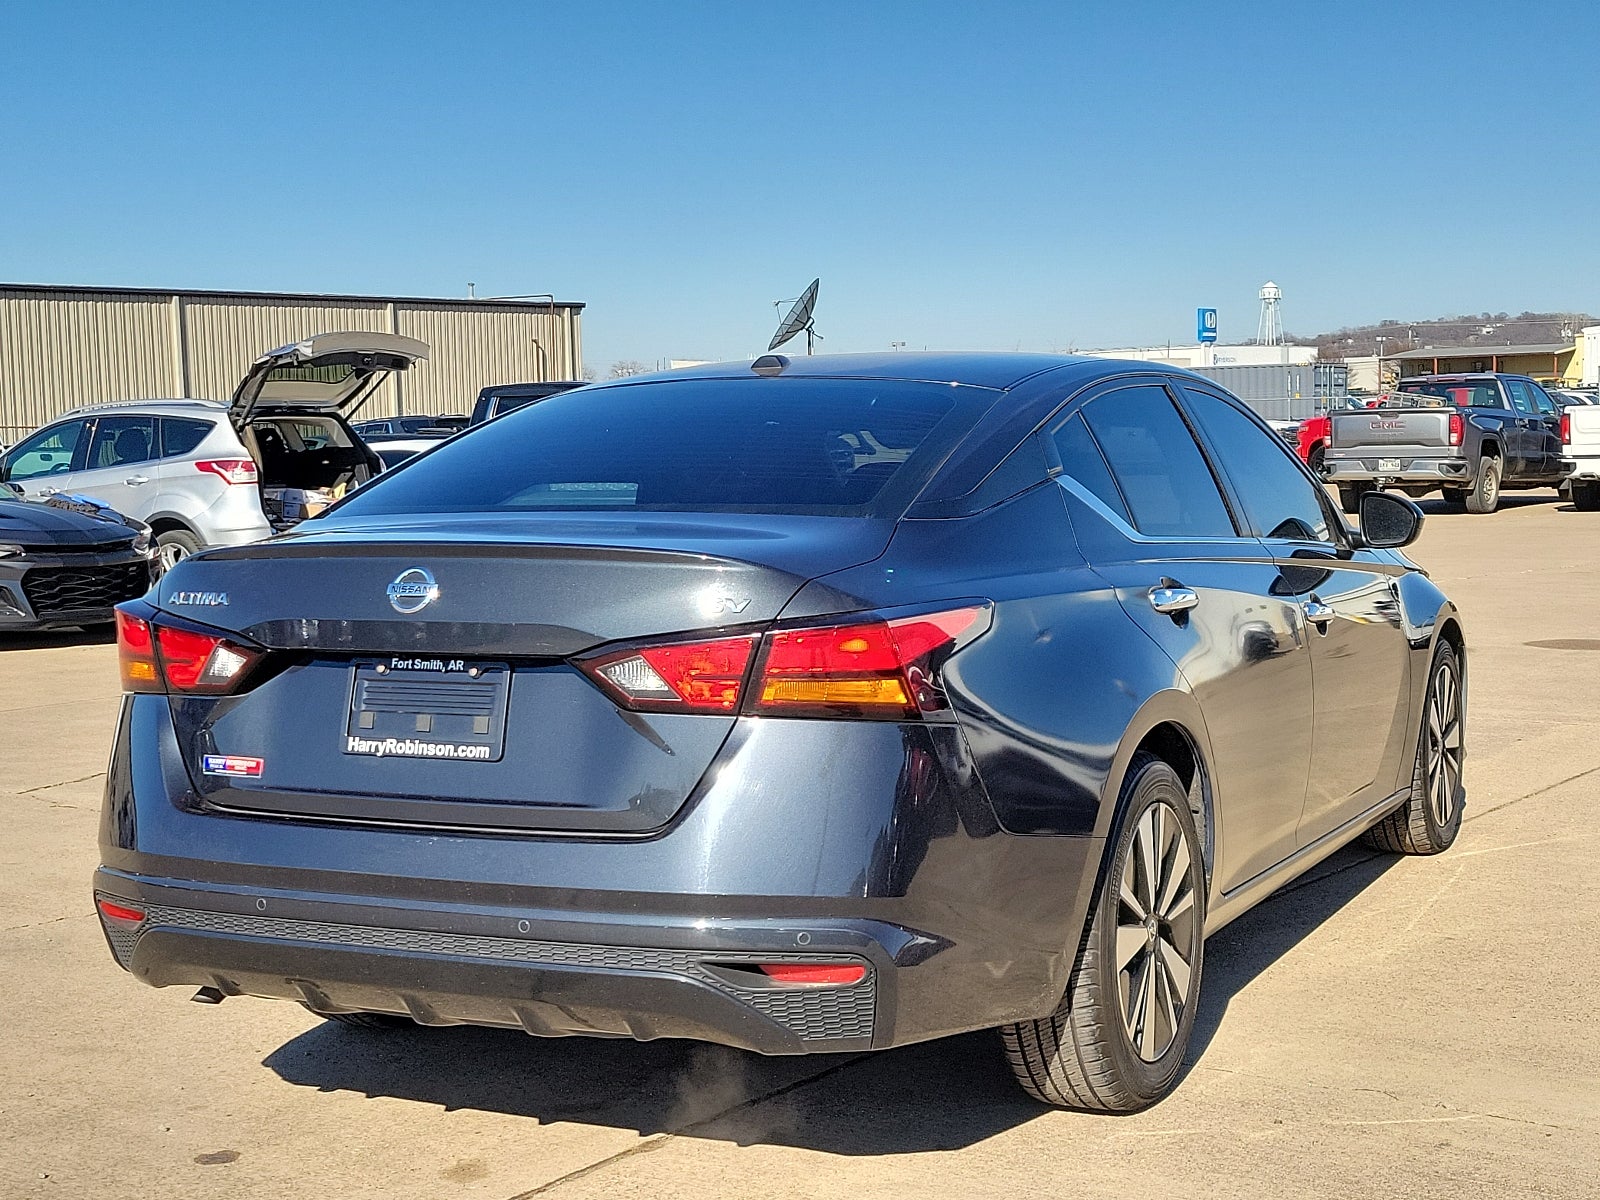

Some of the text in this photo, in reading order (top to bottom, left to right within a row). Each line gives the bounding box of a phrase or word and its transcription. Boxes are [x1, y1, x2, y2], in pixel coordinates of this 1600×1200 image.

[1369, 420, 1406, 430] GMC
[391, 584, 432, 594] NISSAN
[168, 591, 230, 606] ALTIMA
[391, 657, 464, 672] Fort Smith, AR
[347, 736, 490, 759] HarryRobinson.com
